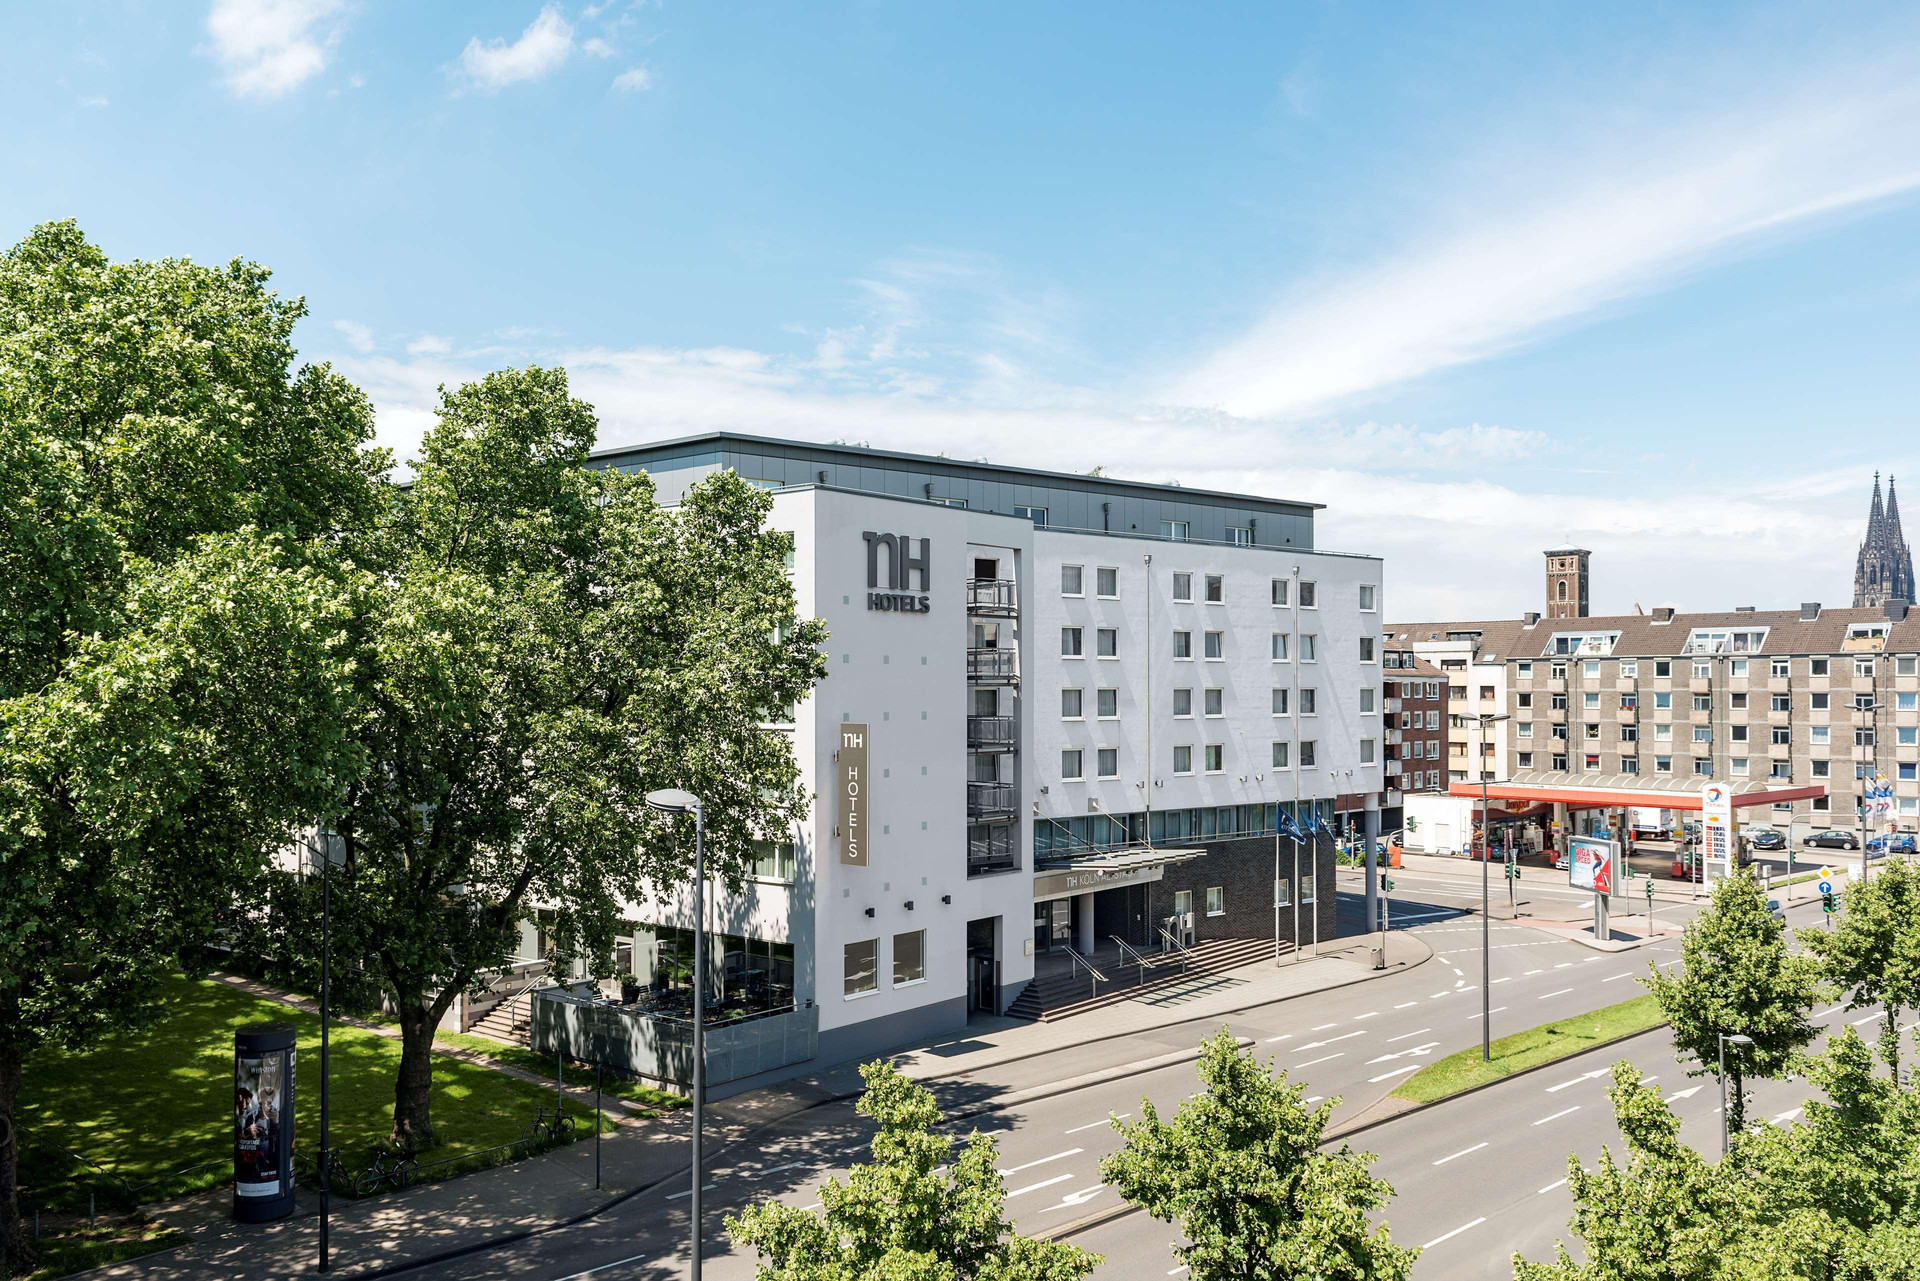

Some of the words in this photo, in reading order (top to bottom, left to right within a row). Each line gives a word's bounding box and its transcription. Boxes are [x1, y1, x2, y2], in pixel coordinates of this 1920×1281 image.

[868, 593, 931, 613] HOTELS
[848, 767, 859, 857] HOTELS
[1575, 846, 1591, 857] GIGA
[1079, 872, 1100, 885] KÖLN
